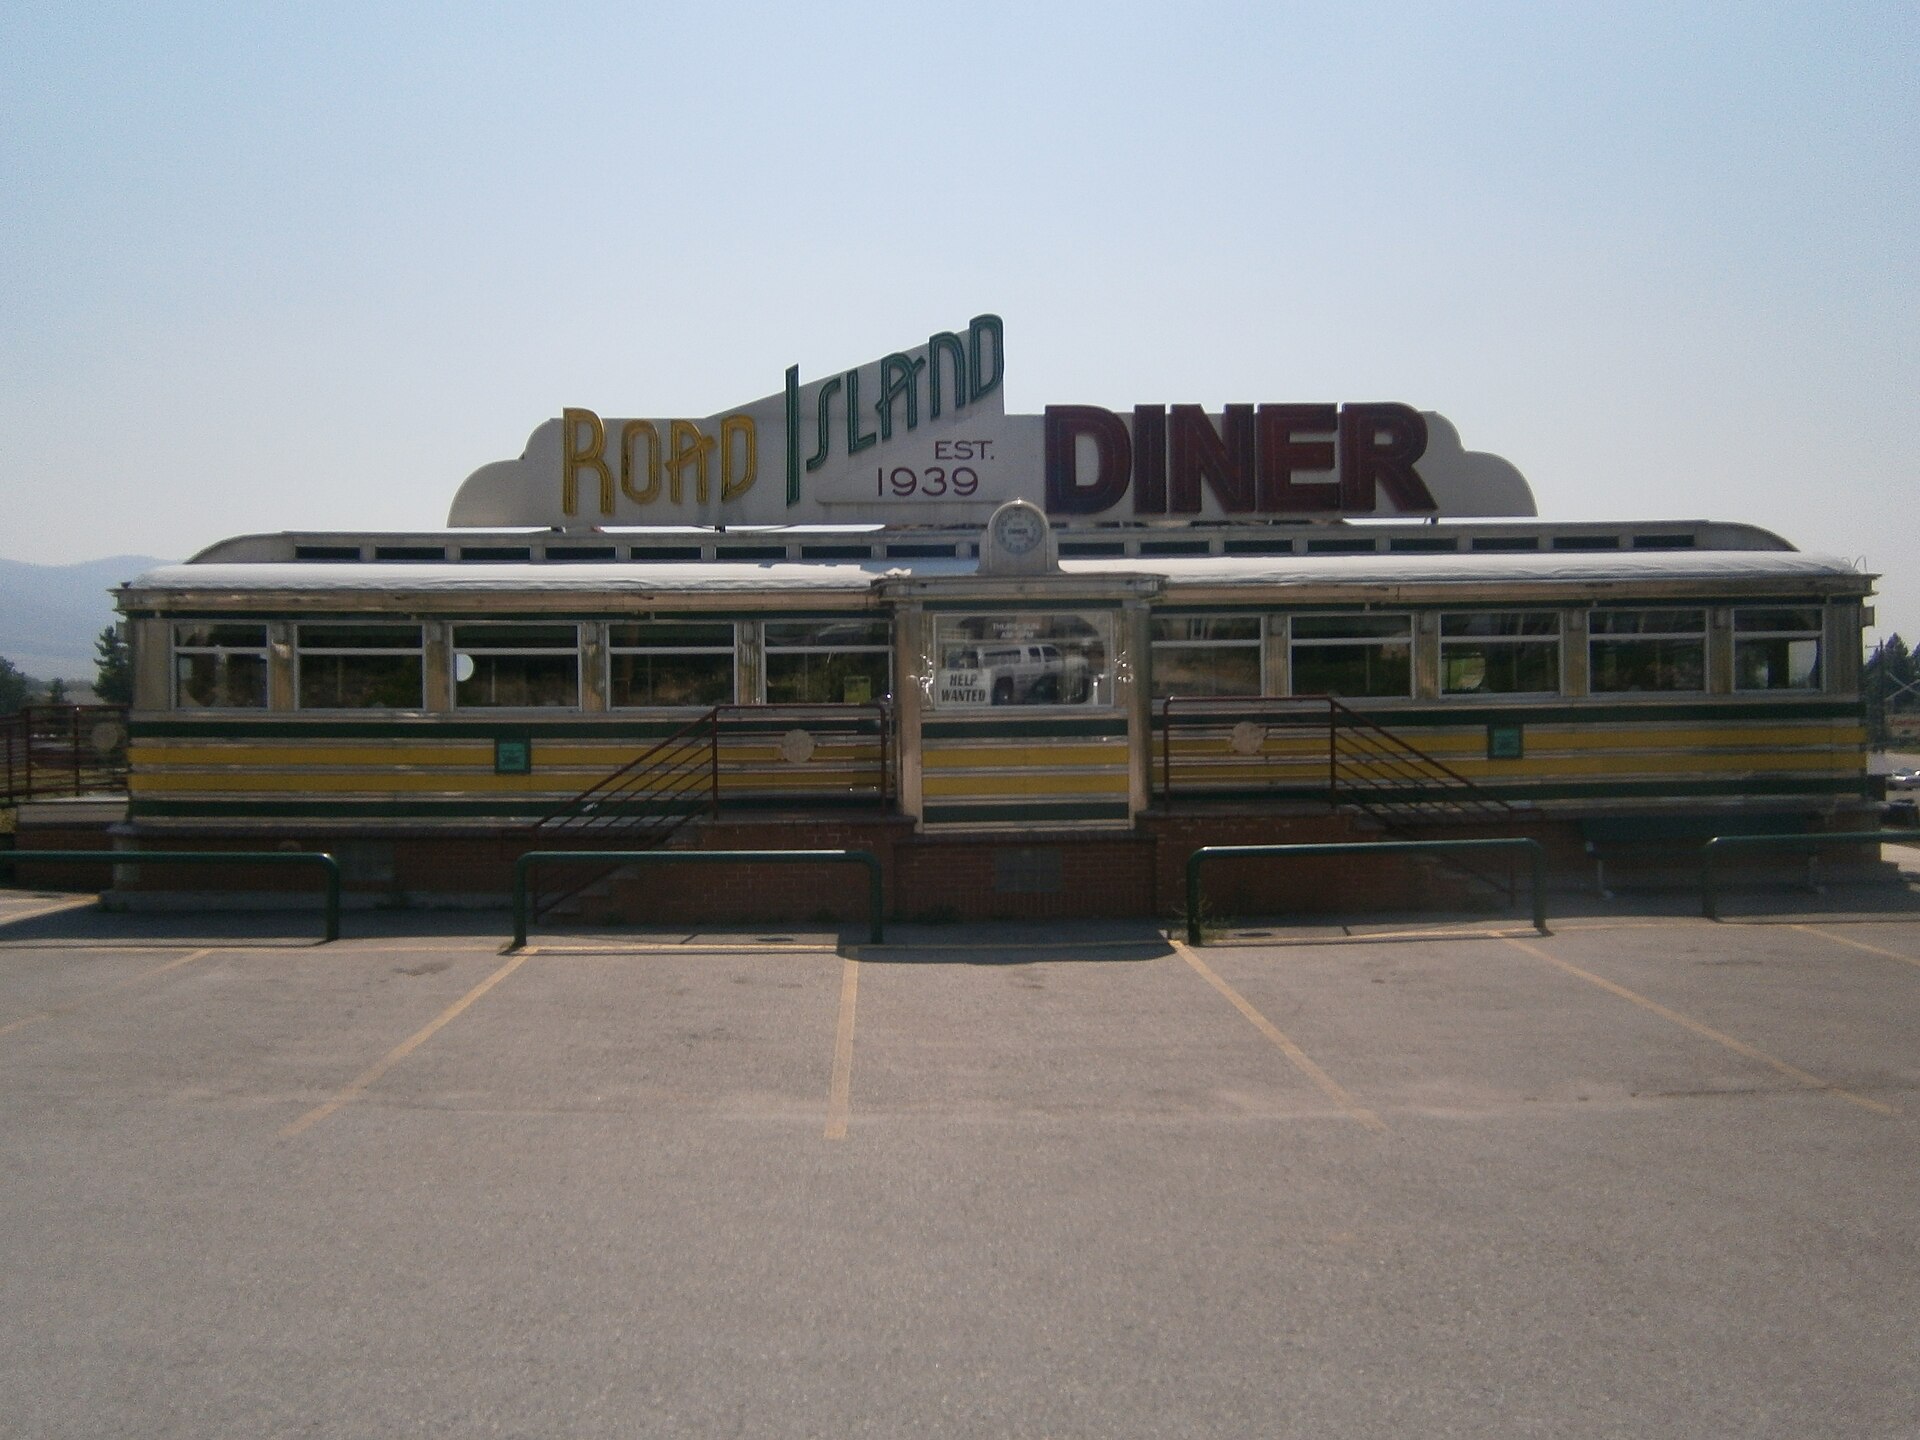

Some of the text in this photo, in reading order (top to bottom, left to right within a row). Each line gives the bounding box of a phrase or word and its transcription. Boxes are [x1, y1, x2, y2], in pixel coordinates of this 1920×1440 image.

[563, 313, 1004, 515] ROAD ISLAND
[935, 440, 995, 460] EST.
[1044, 402, 1438, 515] DINER
[877, 466, 979, 497] 1939
[950, 674, 977, 687] HELP
[941, 689, 986, 702] WANTED
